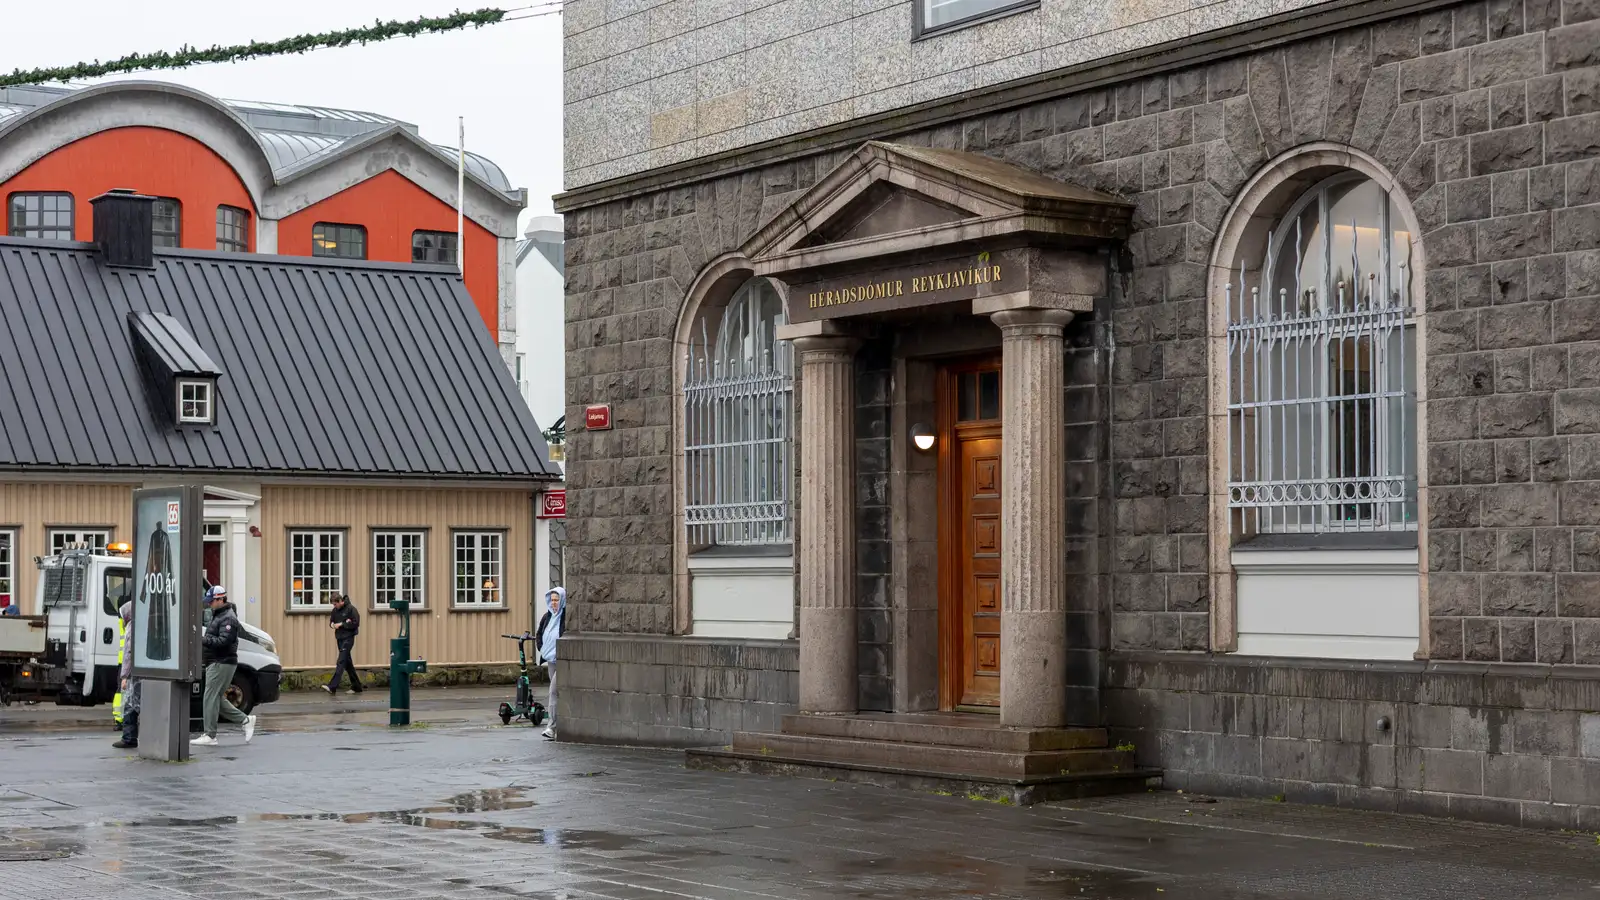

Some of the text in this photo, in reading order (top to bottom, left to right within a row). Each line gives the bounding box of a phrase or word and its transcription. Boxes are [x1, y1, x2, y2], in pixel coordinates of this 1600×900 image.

[809, 265, 1002, 309] HÉRAÐSDÓMUR REYKJAVÍKUR
[169, 504, 178, 523] 66
[144, 572, 176, 594] 100 ár
